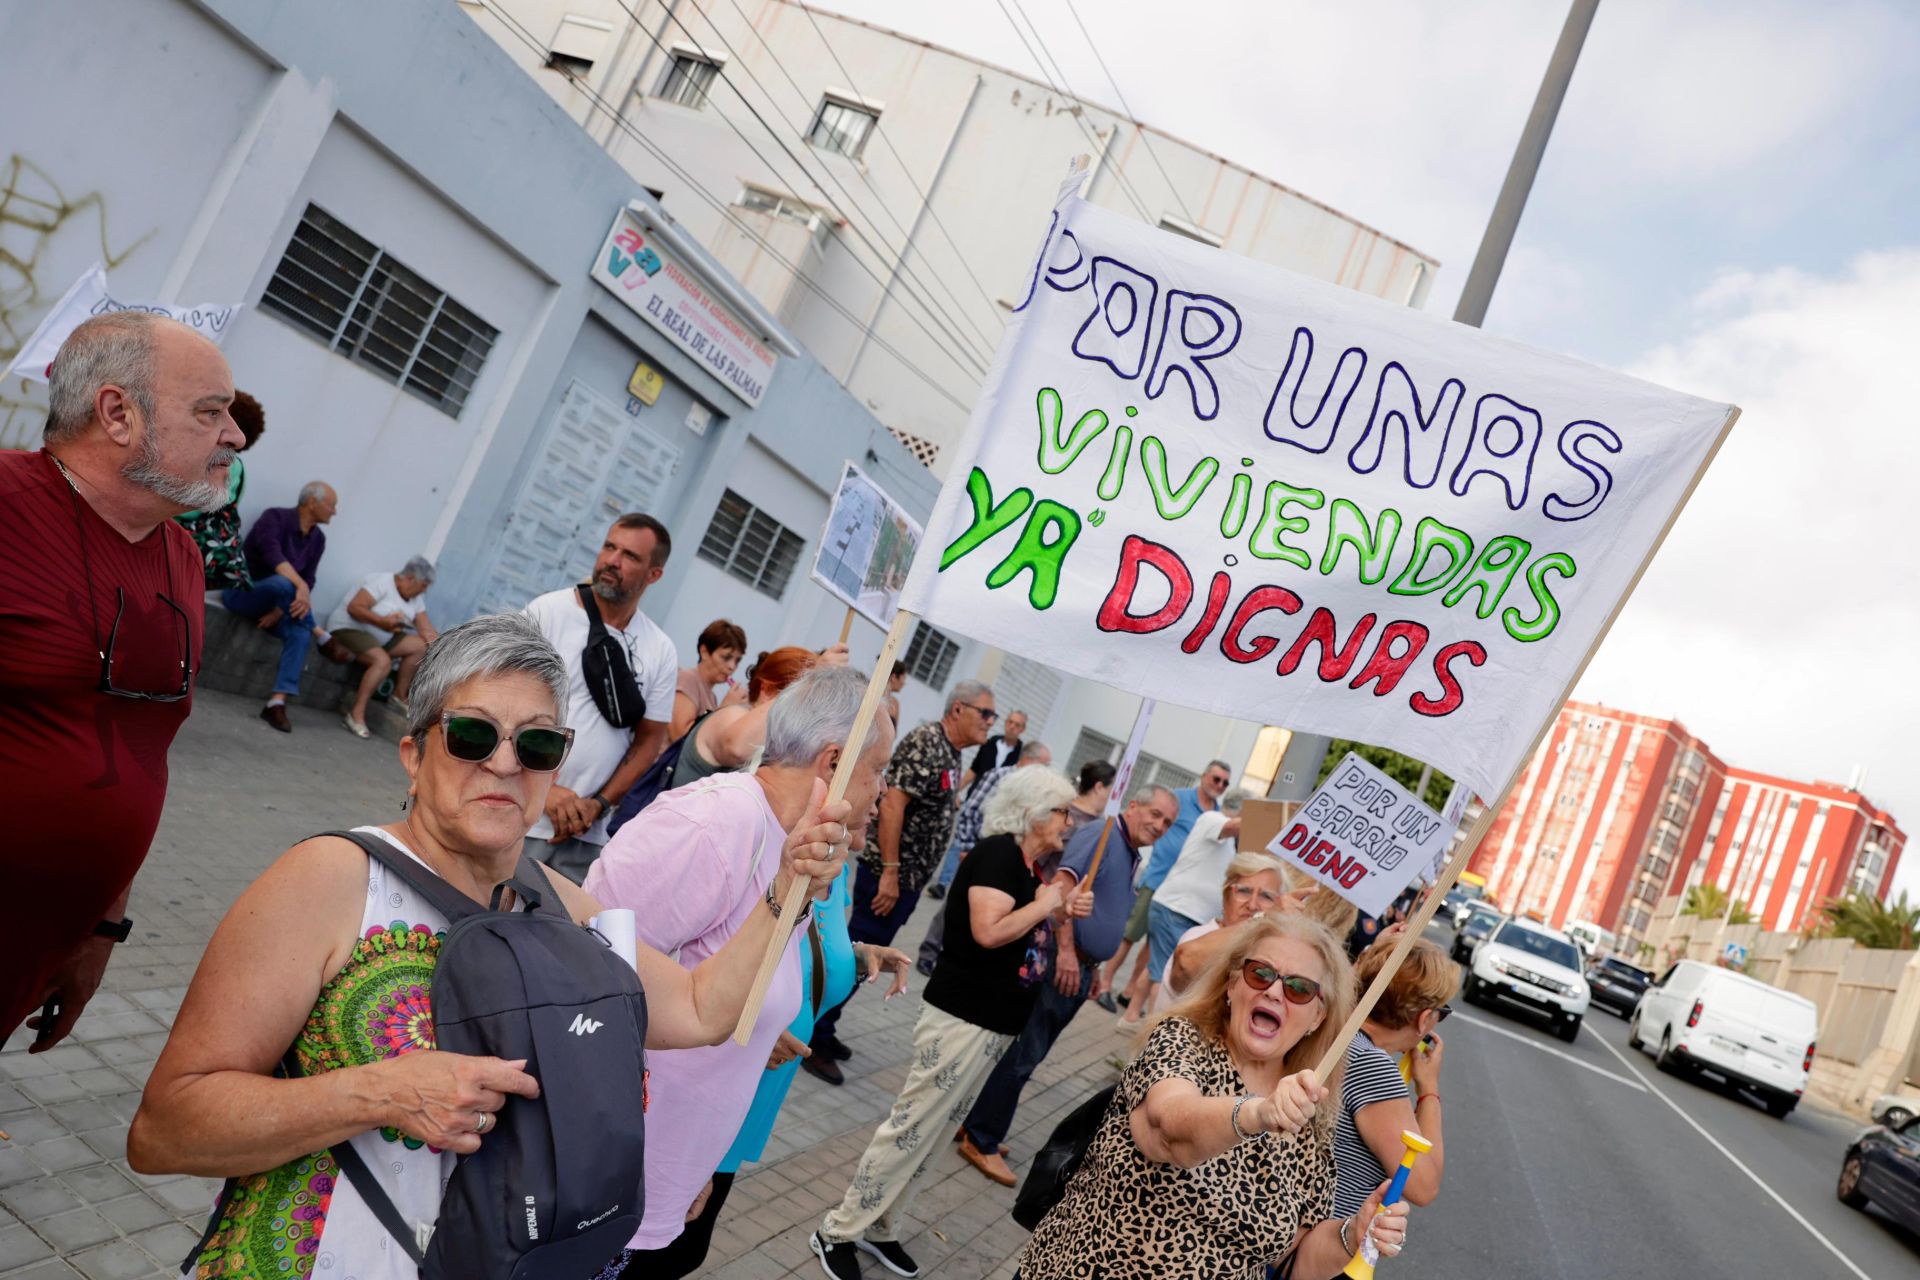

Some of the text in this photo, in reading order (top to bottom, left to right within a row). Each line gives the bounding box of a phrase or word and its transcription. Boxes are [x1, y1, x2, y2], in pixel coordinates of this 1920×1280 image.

[645, 294, 662, 317] EL
[661, 308, 691, 341] REAL
[690, 331, 706, 355] DE
[705, 345, 726, 374] LAS
[724, 360, 764, 400] PALMAS
[1263, 327, 1623, 521] UNAS
[1333, 765, 1398, 819] POR
[1391, 804, 1441, 846] UN
[525, 1207, 539, 1240] ARPENAZ
